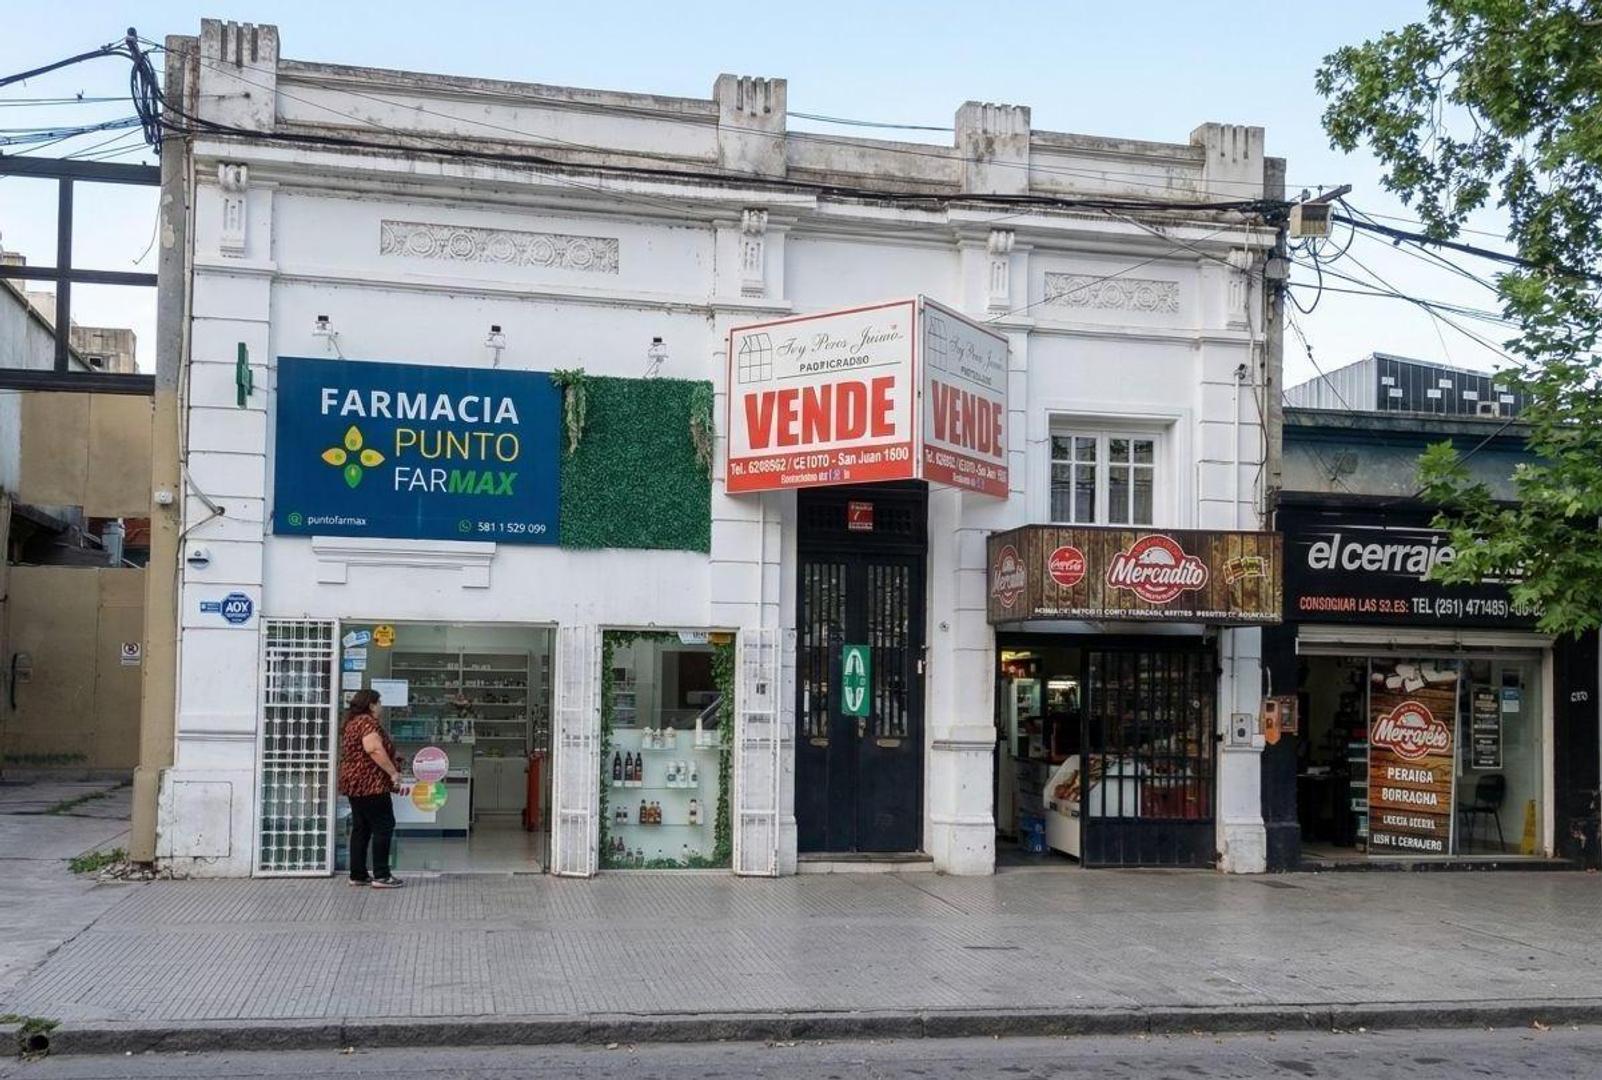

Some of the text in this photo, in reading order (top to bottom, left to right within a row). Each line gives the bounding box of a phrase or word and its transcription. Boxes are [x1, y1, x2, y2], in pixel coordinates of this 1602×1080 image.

[321, 387, 520, 424] FARMACIA
[744, 376, 895, 449] VENDE
[931, 379, 1003, 459] VENDE
[395, 428, 520, 463] PUNTO
[730, 463, 746, 475] Tel.
[838, 452, 857, 466] San
[858, 450, 881, 464] Juan
[394, 467, 518, 496] FARMAX
[307, 514, 367, 527] puntofarmax
[478, 522, 496, 533] 581
[507, 523, 526, 533] 529
[528, 524, 547, 534] 099
[1308, 533, 1341, 570] el
[1111, 557, 1204, 585] Mercadito
[1359, 598, 1377, 612] LAS
[1412, 598, 1433, 613] TEL
